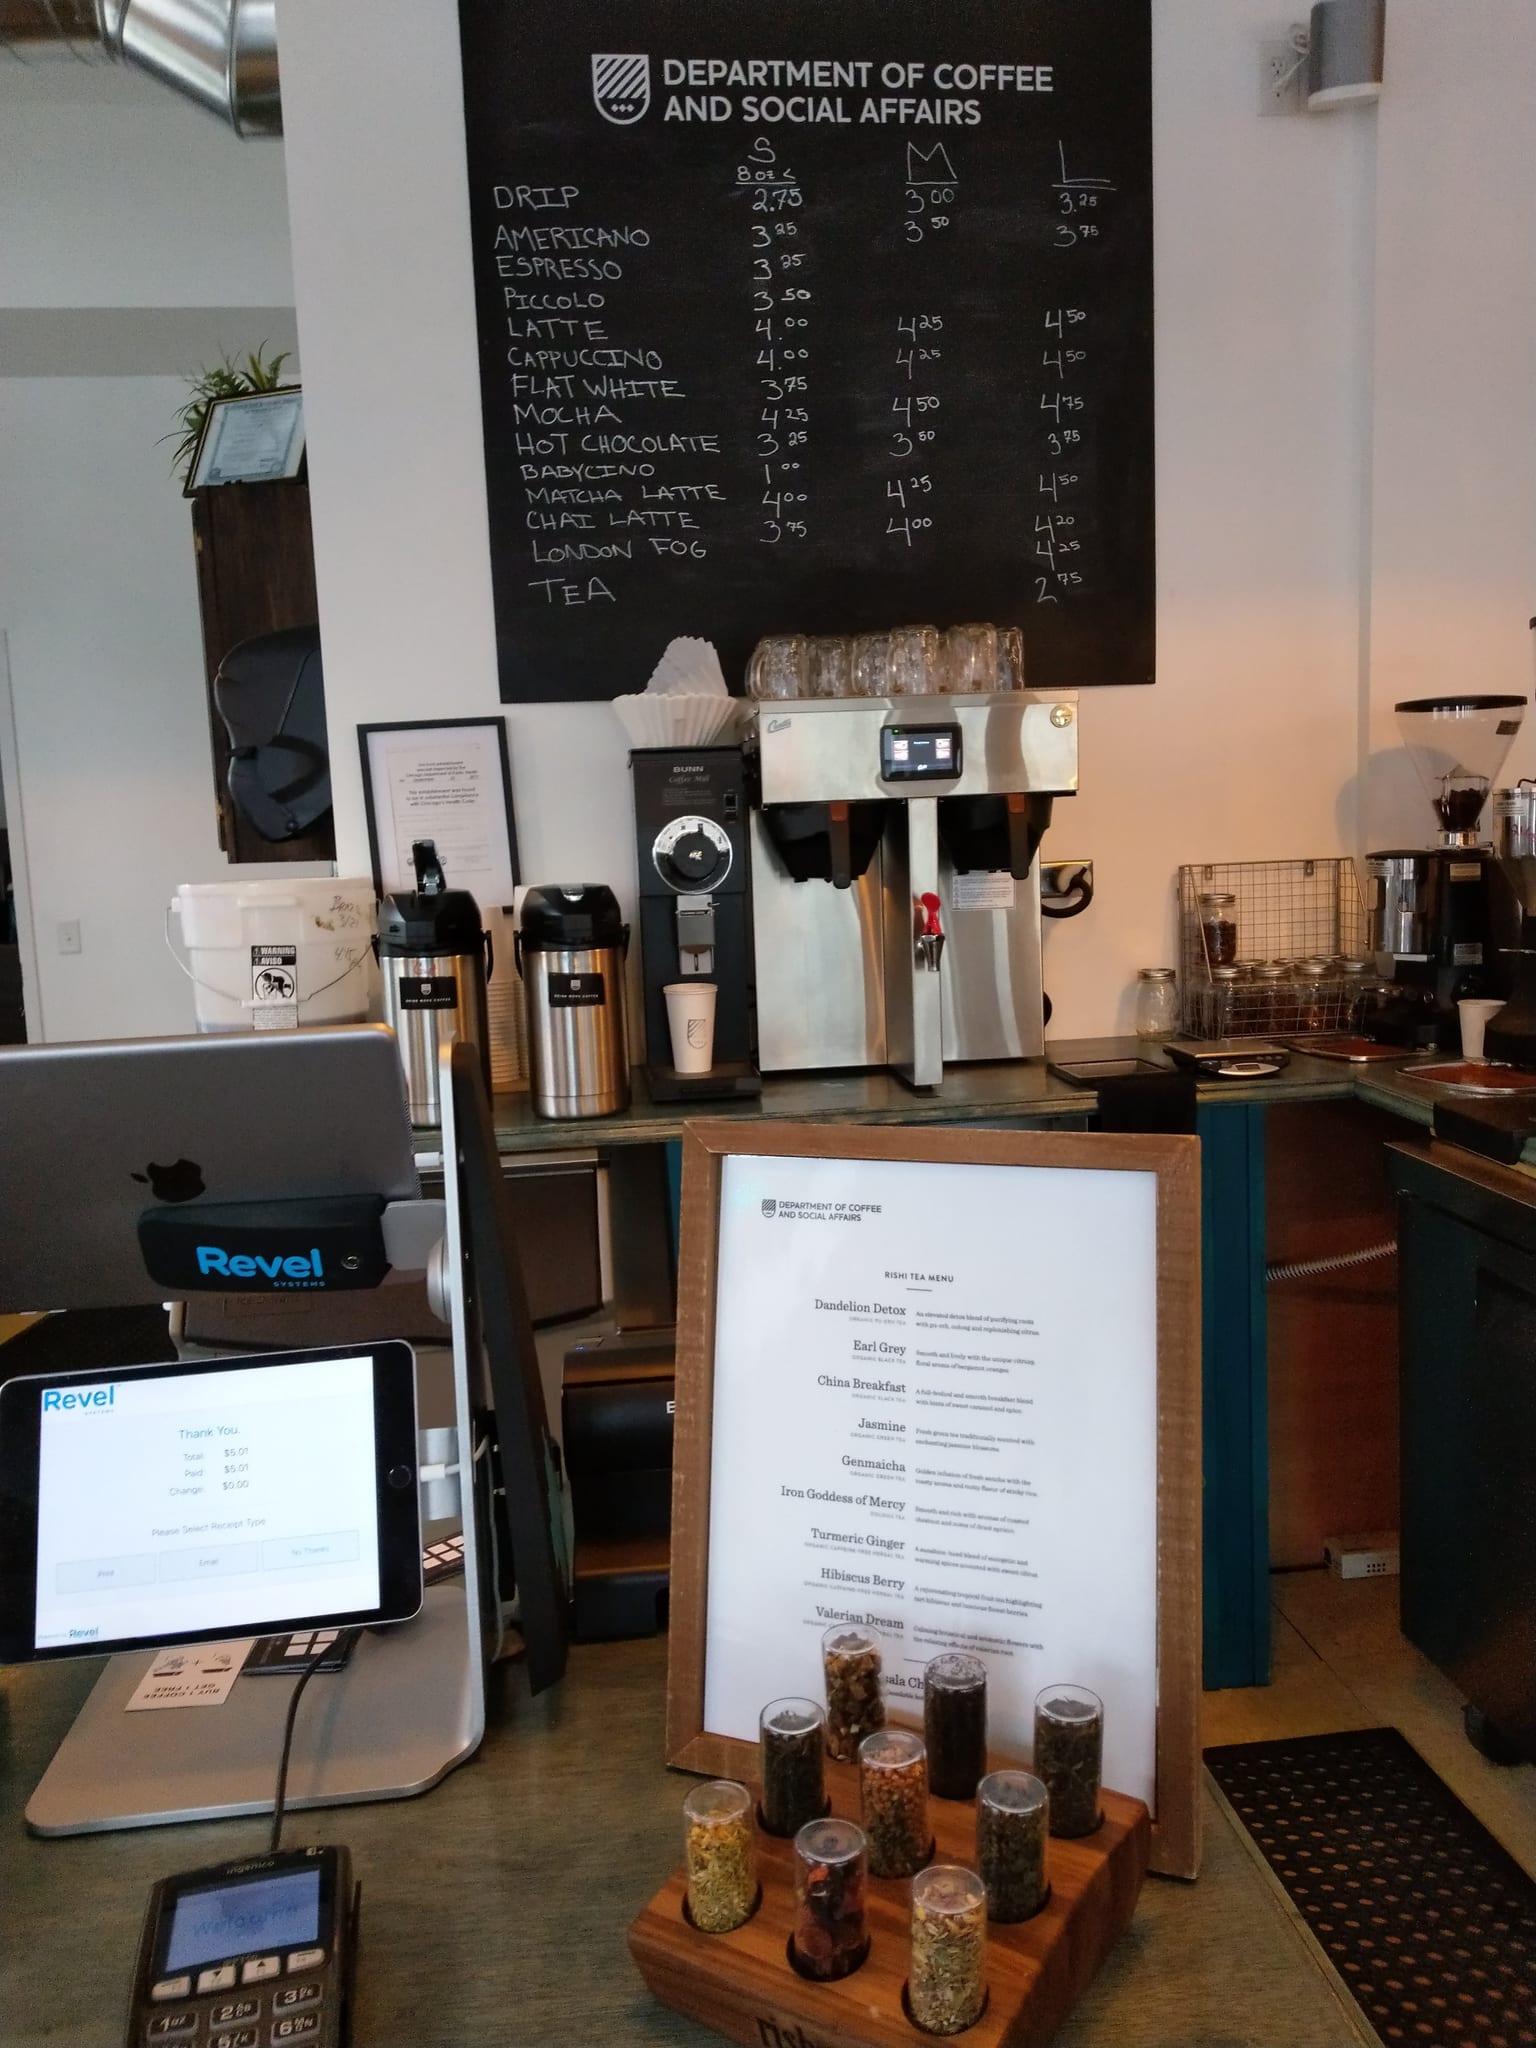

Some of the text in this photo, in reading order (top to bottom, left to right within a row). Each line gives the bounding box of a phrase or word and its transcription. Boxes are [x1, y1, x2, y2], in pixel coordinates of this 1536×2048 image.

[664, 59, 1054, 92] DEPARTMENT OF COFFEE
[664, 96, 982, 126] AND SOCIAL AFFAIRS
[747, 136, 776, 163] S
[906, 141, 957, 181] M
[1058, 139, 1111, 183] L
[493, 186, 580, 210] DRIP
[752, 188, 803, 212] 2.75
[494, 224, 650, 251] AMERICANO
[495, 255, 622, 280] ESPRESSO
[503, 287, 605, 310] PICCOLO
[507, 317, 608, 340] LATTE
[507, 347, 663, 371] CAPPUCCINO
[510, 373, 686, 399] FLAT WHITE
[513, 403, 623, 425] MOCHA
[515, 432, 721, 456] HOT CHOCOLATE
[519, 463, 656, 482] BABYCINO
[525, 484, 727, 504] MATCHA LATTE
[526, 509, 700, 530] CHAI LATTE
[532, 538, 707, 563] LONDON FOG
[527, 576, 617, 606] TEA
[673, 765, 704, 773] BUNN
[260, 957, 283, 966] AVISO
[261, 947, 296, 956] WARNING
[778, 1200, 882, 1214] DEPARTMENT OF COFFEE
[778, 1211, 862, 1222] AND SOCIAL AFFAIRS
[196, 1245, 324, 1278] Revel
[884, 1271, 954, 1283] RISHI TEA MENU
[814, 1299, 871, 1314] Dandelion
[873, 1303, 906, 1316] Detox
[853, 1339, 906, 1356] Earl Grey
[817, 1375, 906, 1393] China Breakfast
[43, 1385, 115, 1412] Revel
[178, 1426, 214, 1440] Thank
[858, 1418, 907, 1432] Jasmine
[841, 1455, 906, 1472] Genmaicha
[222, 1480, 250, 1491] $0.00
[780, 1485, 906, 1512] Iron Goddess of Mercy
[151, 1517, 266, 1537] Please Select Receipt Type
[810, 1528, 864, 1545] Turmeric
[866, 1535, 906, 1551] Ginger
[820, 1567, 871, 1585] Hibiscus
[872, 1574, 906, 1591] Berry
[815, 1606, 864, 1624] Valerian
[865, 1613, 905, 1630] Dream
